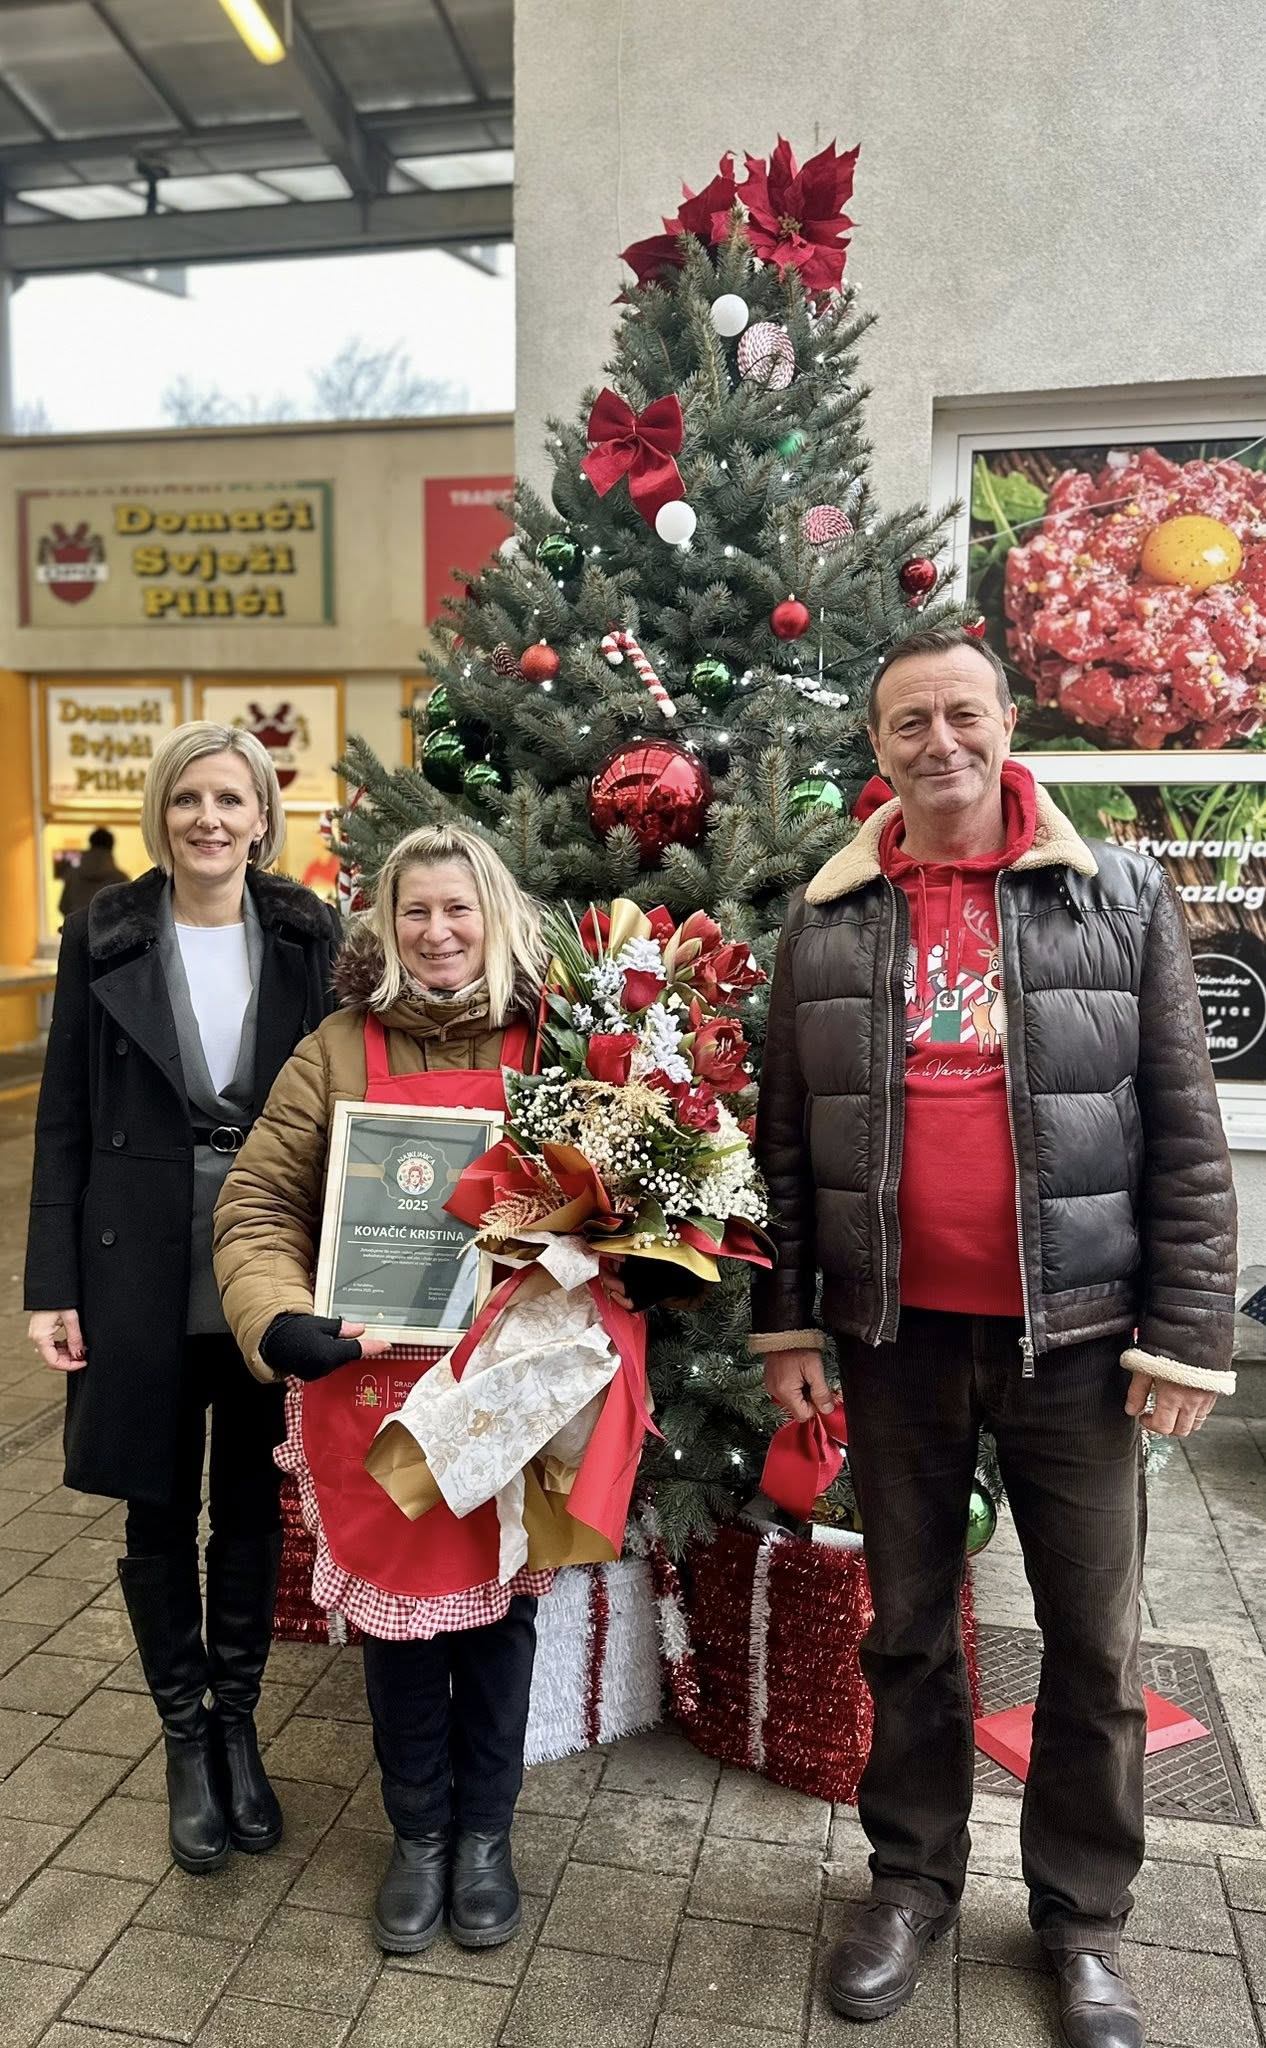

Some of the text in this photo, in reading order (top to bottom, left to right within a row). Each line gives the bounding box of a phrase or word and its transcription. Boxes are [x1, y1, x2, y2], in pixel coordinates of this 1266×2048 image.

[115, 501, 313, 534] Domaći
[133, 544, 294, 580] Svježi
[144, 586, 284, 617] Pilići
[1194, 973, 1251, 985] icionalno
[397, 1199, 428, 1211] 2025
[354, 1225, 465, 1242] KOVAČIĆ KRISTINA
